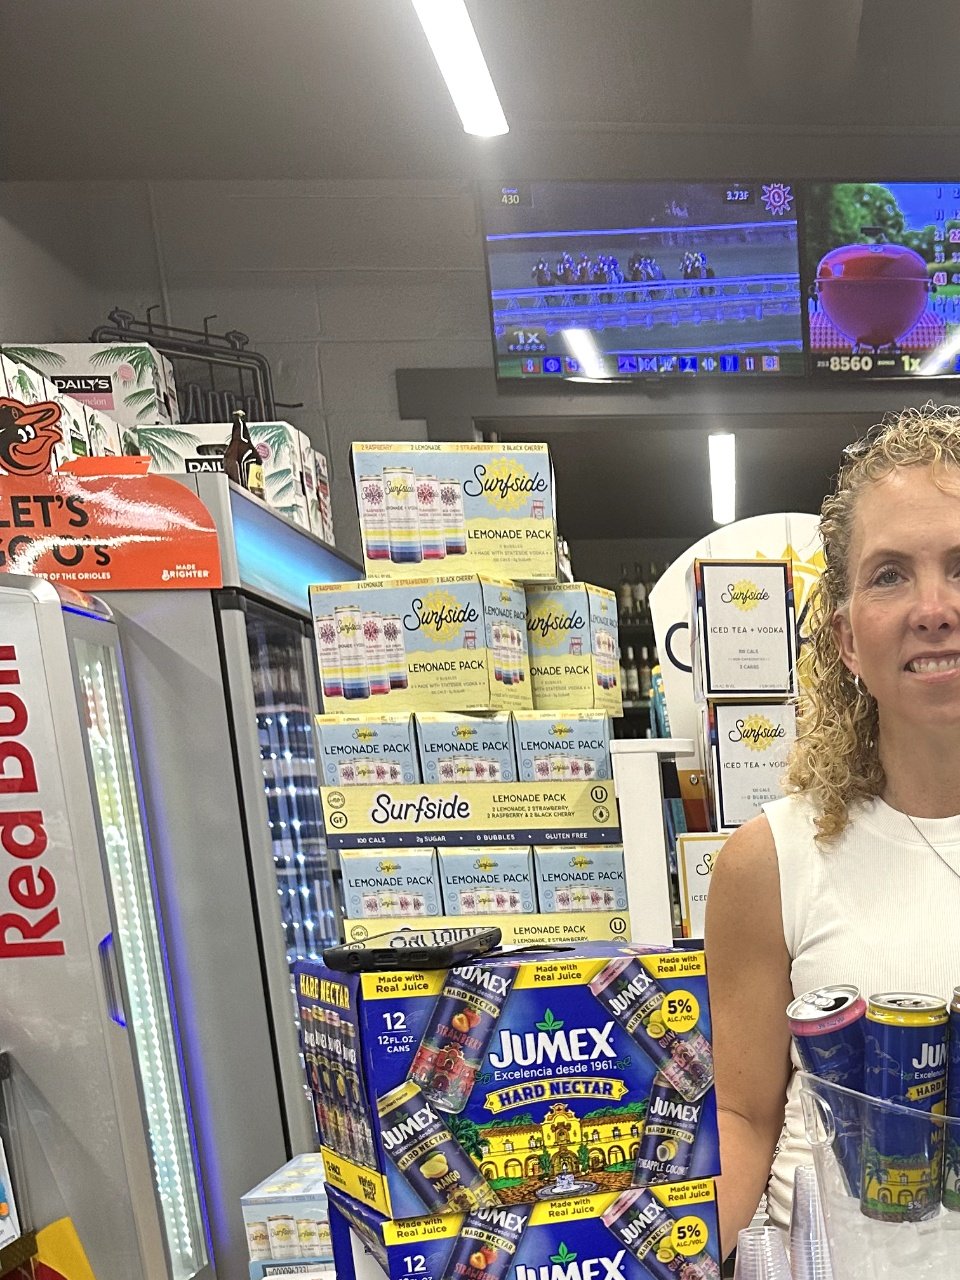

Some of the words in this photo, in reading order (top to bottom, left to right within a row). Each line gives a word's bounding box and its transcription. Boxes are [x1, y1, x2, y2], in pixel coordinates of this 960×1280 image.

[501, 194, 519, 204] 430
[830, 356, 872, 371] 8560
[56, 378, 109, 391] DAILY'S
[463, 465, 548, 498] Surfside
[468, 530, 522, 539] LEMONADE
[525, 530, 551, 539] PACK
[721, 584, 769, 603] Surfside
[403, 598, 478, 631] Surfside
[409, 662, 457, 673] LEMONADE
[460, 661, 484, 670] PACK
[567, 665, 589, 675] PACK
[729, 719, 786, 742] Surfside
[325, 745, 381, 754] LEMONADE
[384, 743, 410, 753] PACK
[425, 743, 479, 753] LEMONADE
[483, 741, 508, 751] PACK
[521, 741, 575, 750] LEMONADE
[578, 740, 604, 749] PACK
[493, 795, 541, 803] LEMONADE
[544, 793, 566, 801] PACK
[372, 793, 470, 824] Surfside
[349, 877, 403, 887] LEMONADE
[406, 876, 432, 885] PACK
[446, 875, 499, 885] LEMONADE
[504, 874, 529, 883] PACK
[542, 872, 595, 882] LEMONADE
[599, 871, 623, 881] PACK
[0, 810, 65, 957] Red
[514, 926, 560, 934] LEMONADE
[563, 925, 586, 933] PACK
[377, 976, 401, 985] Made
[404, 973, 425, 982] with
[300, 973, 318, 999] HARD
[321, 979, 350, 1010] NECTAR
[376, 983, 397, 993] Real
[400, 981, 429, 991] Juice
[667, 999, 691, 1015] 5%
[383, 1012, 406, 1030] 12
[387, 1044, 410, 1053] CANS
[490, 1021, 617, 1068] JUMEX
[494, 1067, 555, 1080] Excelencia
[559, 1063, 587, 1076] desde
[498, 1086, 547, 1107] HARD
[550, 1082, 613, 1097] NECTAR
[916, 1082, 940, 1096] HARD
[907, 1201, 921, 1210] 5%
[677, 1225, 701, 1239] 5%
[404, 1255, 426, 1272] 12
